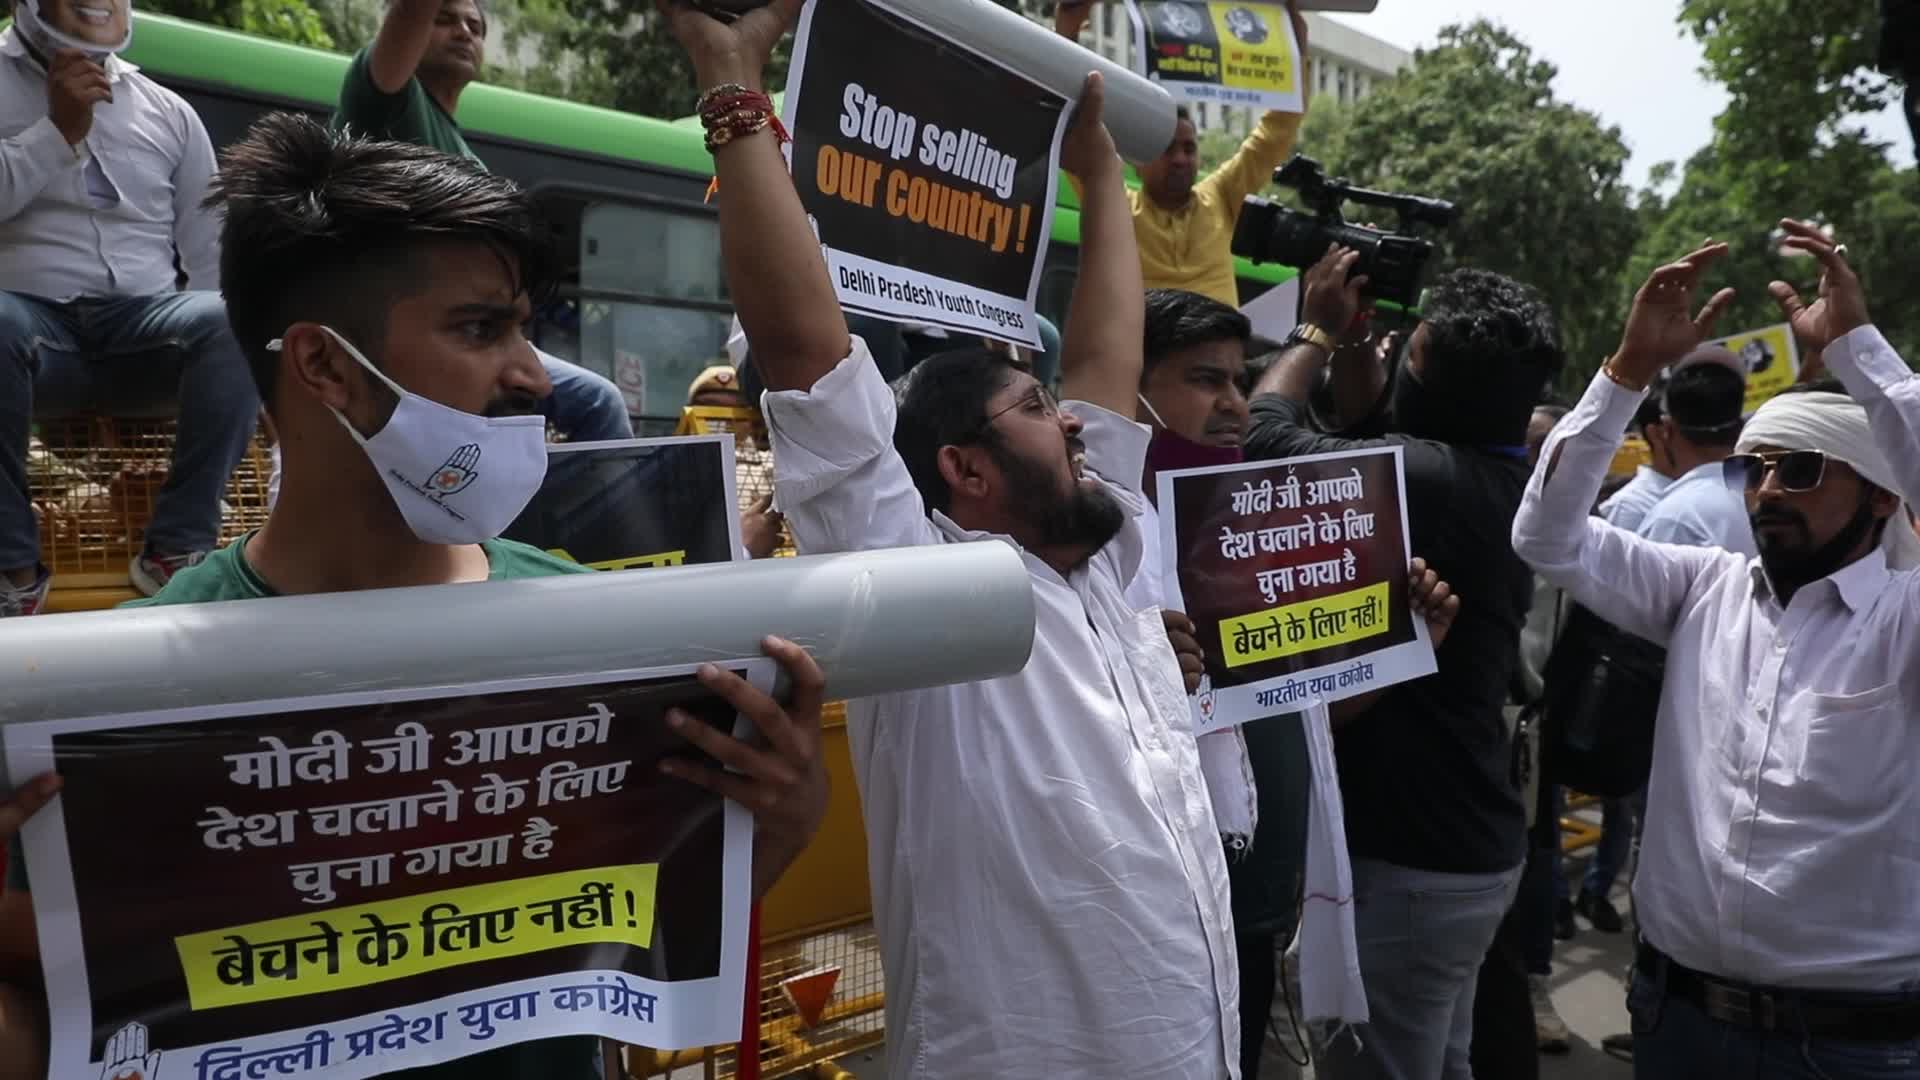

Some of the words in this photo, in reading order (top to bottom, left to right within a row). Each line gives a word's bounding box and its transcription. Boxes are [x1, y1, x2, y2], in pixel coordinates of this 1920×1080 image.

[839, 83, 916, 160] Stop
[919, 123, 1017, 199] selling
[816, 144, 883, 208] our
[839, 265, 876, 297] Delhi
[878, 275, 933, 308] Pradesh
[936, 290, 975, 317] Youth
[976, 300, 1024, 329] Congress
[1231, 480, 1273, 516] मोदी
[1275, 474, 1300, 508] जी
[1305, 468, 1364, 507] आपको
[1219, 526, 1255, 560] देश
[1258, 515, 1315, 554] चलाने
[1318, 513, 1341, 544] के
[1343, 512, 1375, 540] लिए
[1256, 565, 1293, 603] चुना
[1299, 558, 1341, 588] गया
[1344, 548, 1357, 581] है
[1232, 615, 1282, 655] बेचने
[1287, 612, 1307, 643] के
[1309, 606, 1347, 641] लिए
[1255, 678, 1307, 707] भारतीय
[223, 730, 352, 789] मोदी
[361, 721, 434, 774] जी
[444, 703, 615, 766] आपको
[197, 806, 299, 851] देश
[307, 779, 464, 836] चलाने
[472, 773, 530, 815] के
[537, 760, 632, 806] लिए
[288, 853, 395, 904] चुना
[403, 834, 514, 875] गया
[521, 816, 559, 860] है
[212, 921, 343, 987] बेचने
[352, 913, 411, 968] के
[419, 903, 520, 957] लिए
[193, 1030, 335, 1080] दिल्ली
[345, 1014, 448, 1061] प्रदेश
[457, 991, 541, 1041] युवा
[550, 975, 658, 1024] कांग्रेस
